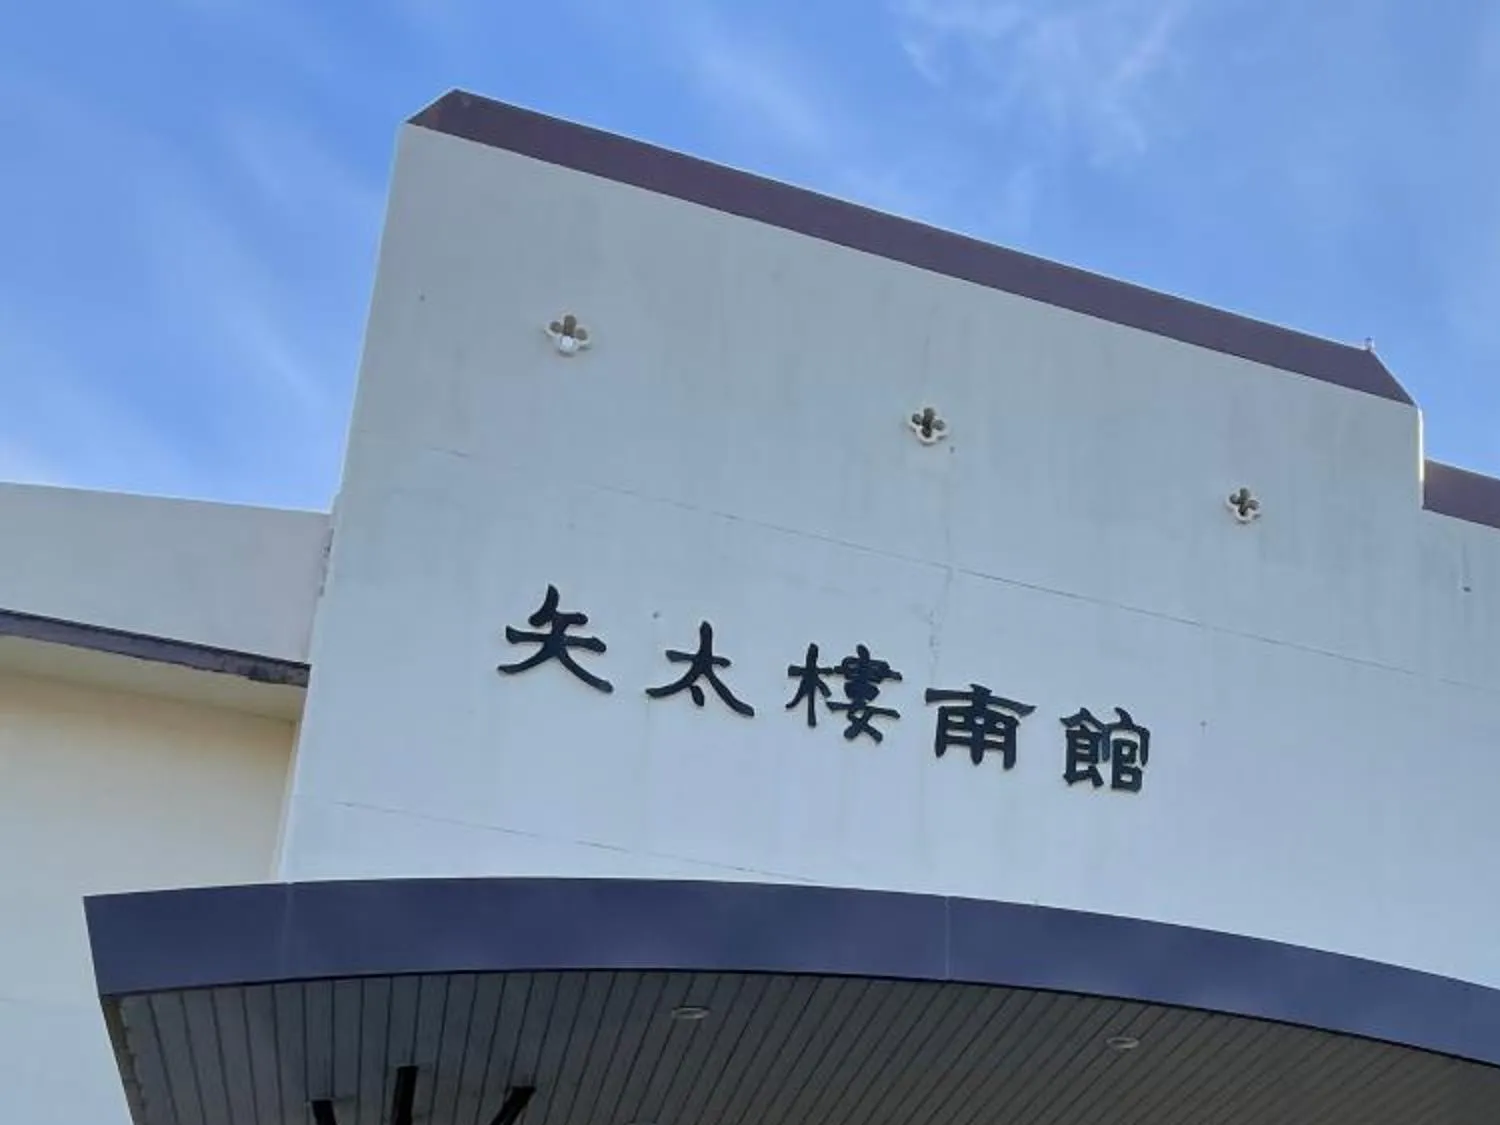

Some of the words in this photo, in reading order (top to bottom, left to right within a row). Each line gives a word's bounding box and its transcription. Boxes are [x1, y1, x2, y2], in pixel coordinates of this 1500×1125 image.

[497, 584, 1150, 792] 矢太樓南館
